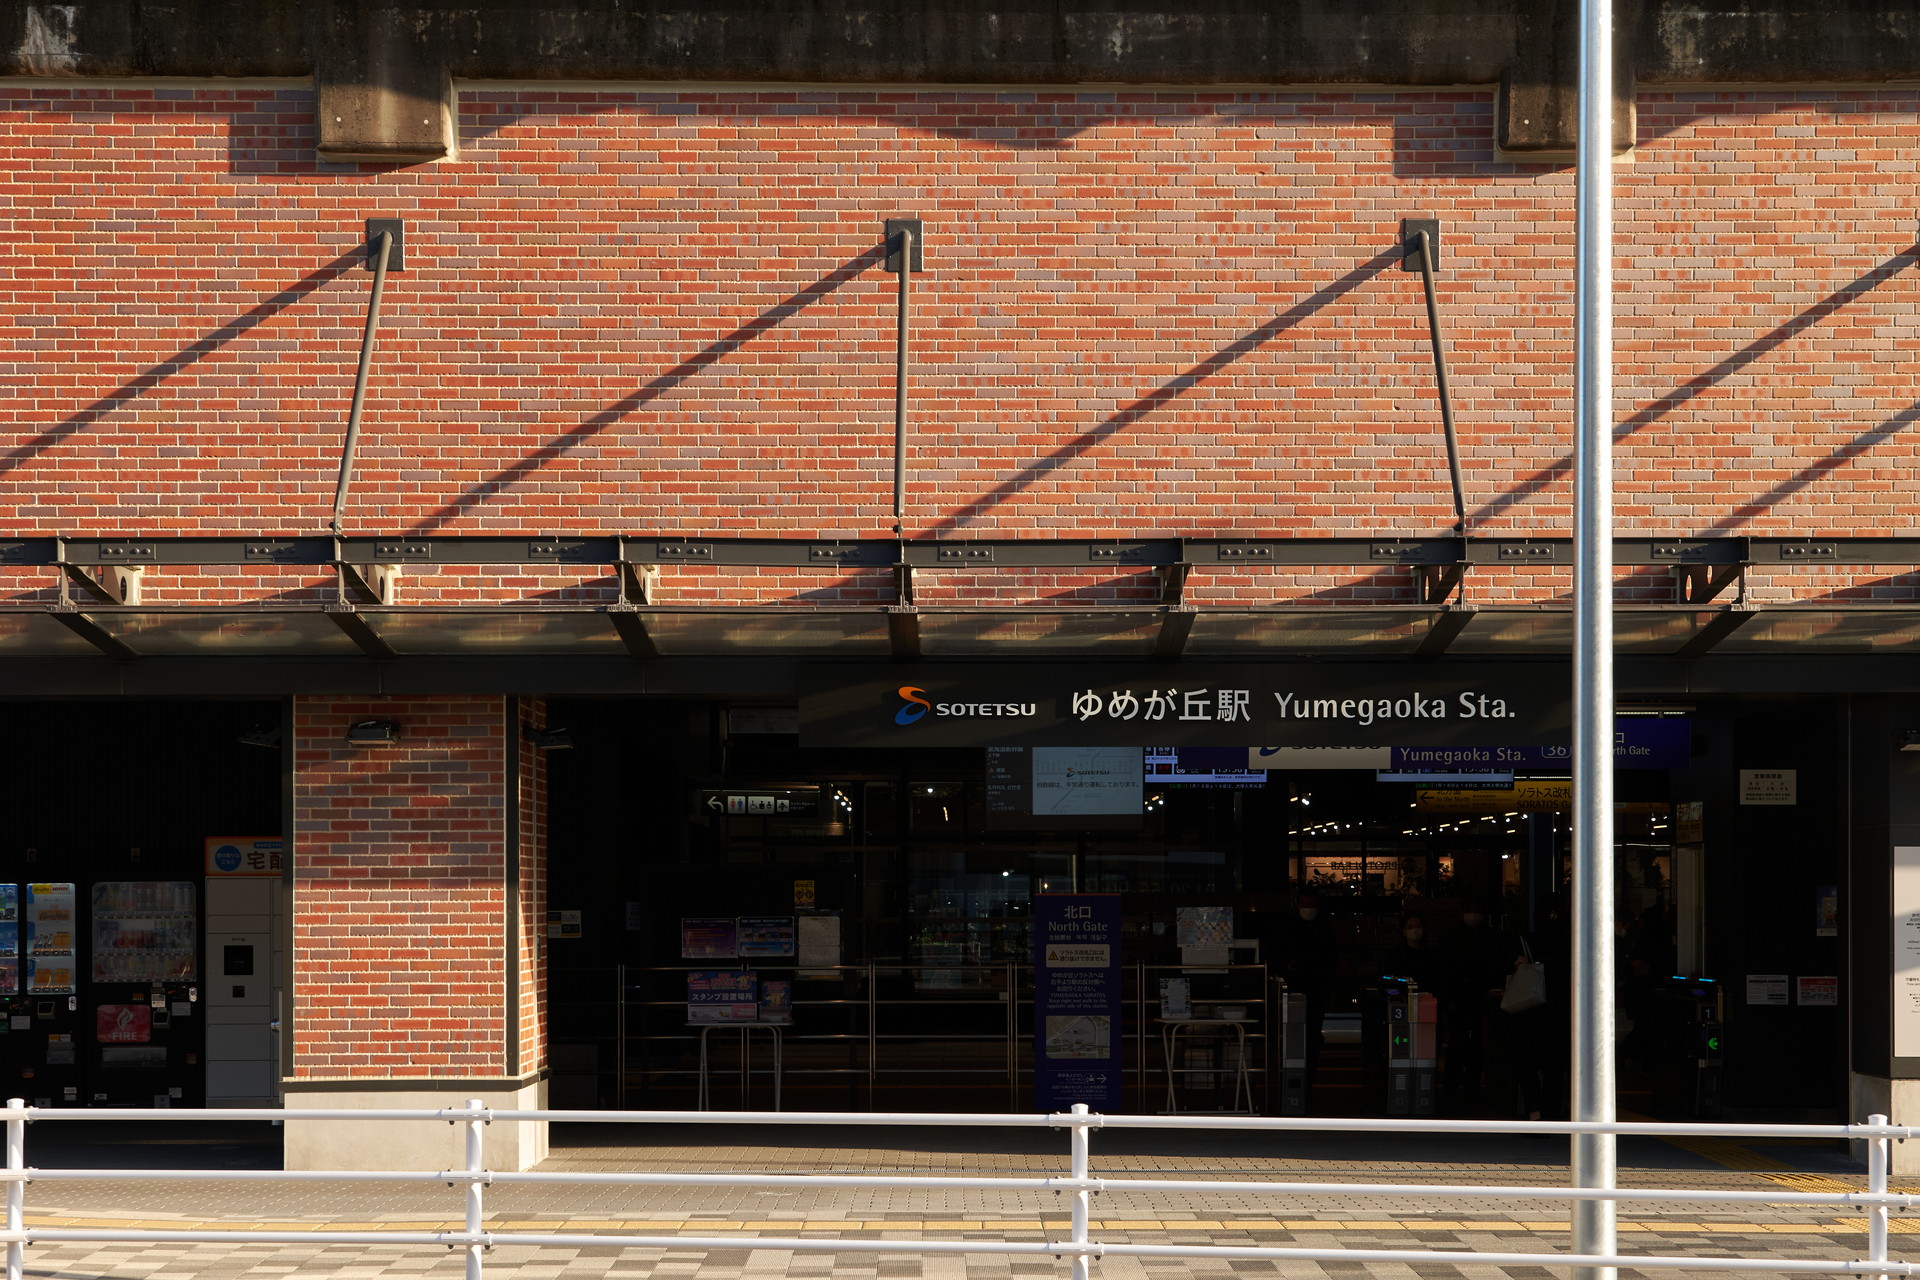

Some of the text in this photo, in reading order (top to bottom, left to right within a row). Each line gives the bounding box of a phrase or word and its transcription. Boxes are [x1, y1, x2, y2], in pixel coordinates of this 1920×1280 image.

[936, 703, 1036, 716] SOTETSU
[1072, 688, 1251, 722] ゆめが丘駅
[1274, 692, 1516, 726] Yumegaoka Sta.
[1615, 732, 1625, 744] 口
[1547, 746, 1567, 756] 36
[1629, 745, 1651, 756] Gate
[1400, 748, 1526, 765] Yumegaoka Sta.
[1517, 800, 1559, 809] SORATOS
[1063, 905, 1092, 919] 北口
[1048, 921, 1109, 932] North Gate
[691, 992, 753, 1001] スタンプ設置場所
[1395, 1008, 1402, 1019] 3
[1704, 1008, 1711, 1019] 1
[112, 1031, 138, 1041] FIRE
